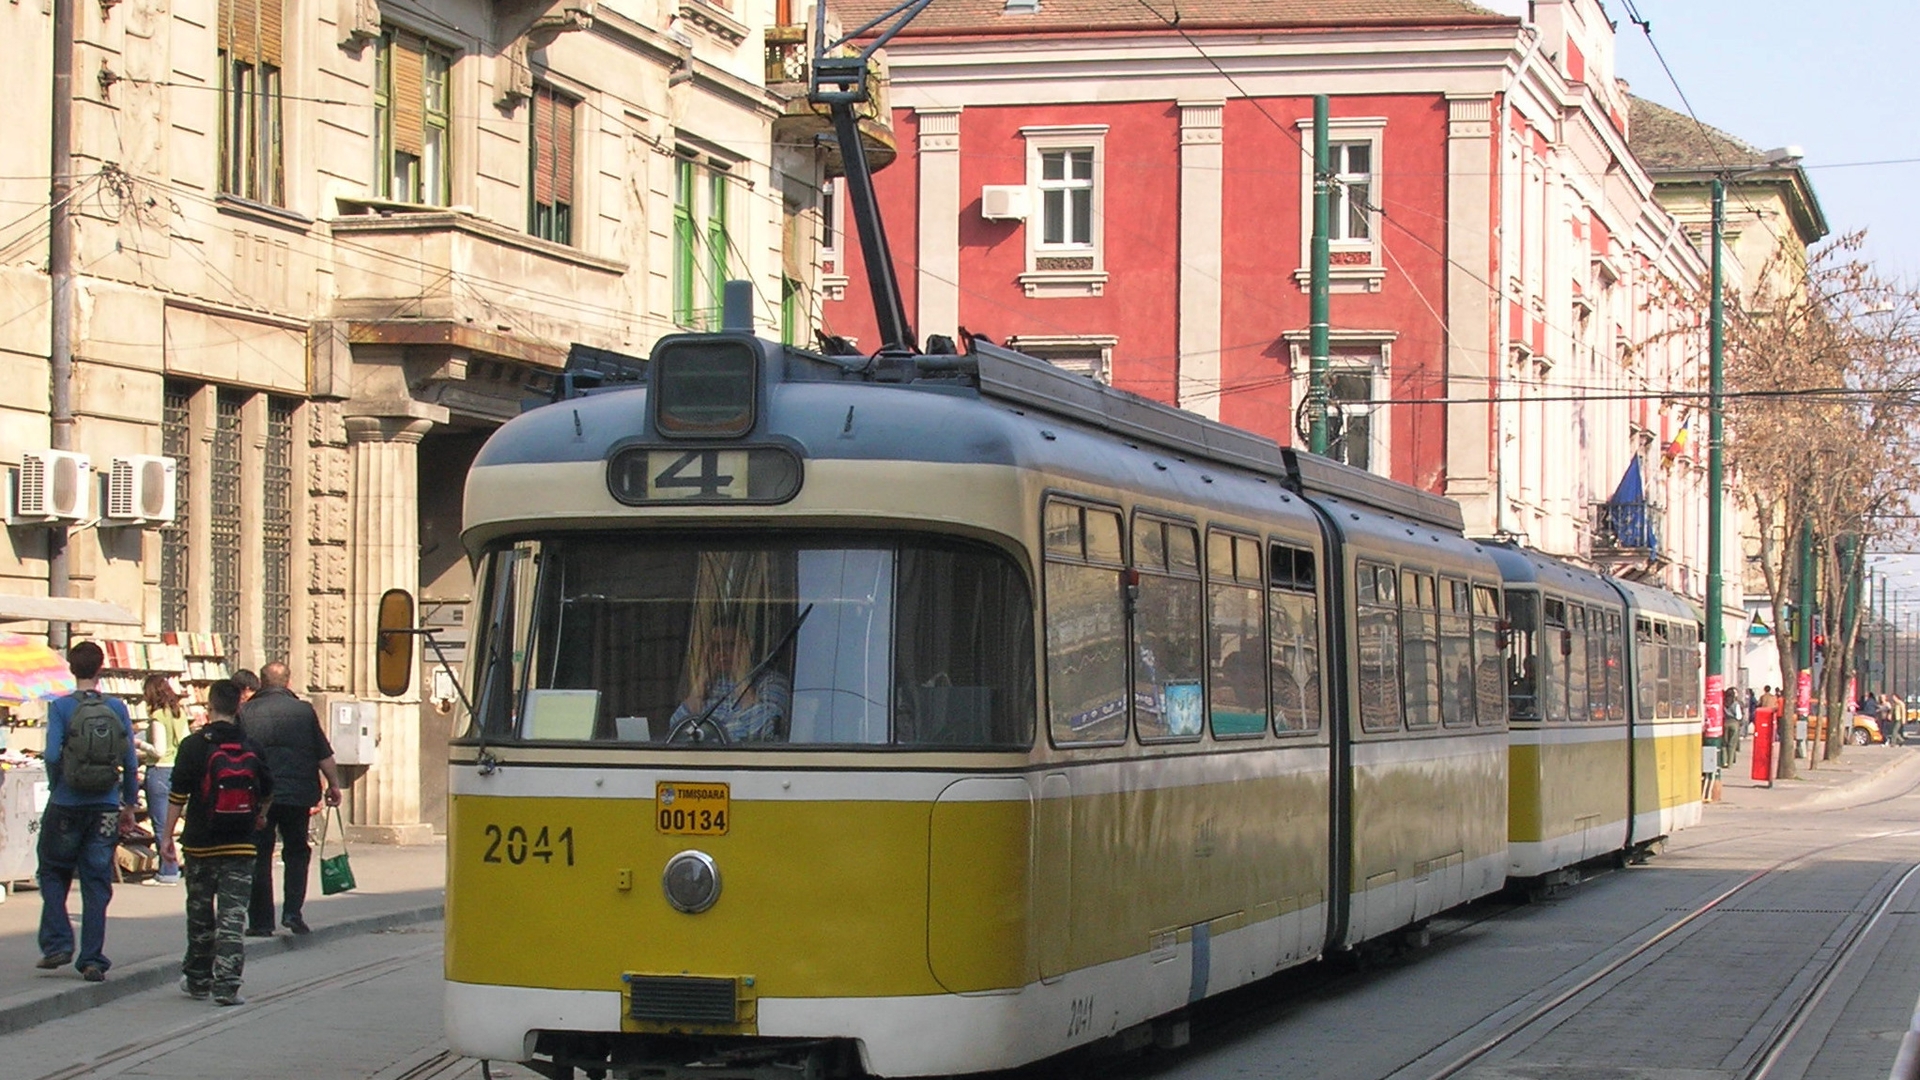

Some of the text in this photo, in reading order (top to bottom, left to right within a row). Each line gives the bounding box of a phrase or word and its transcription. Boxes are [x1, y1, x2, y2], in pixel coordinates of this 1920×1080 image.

[655, 450, 734, 499] 4
[660, 809, 726, 831] 00134
[483, 824, 575, 867] 2041
[1067, 995, 1094, 1038] 2041
